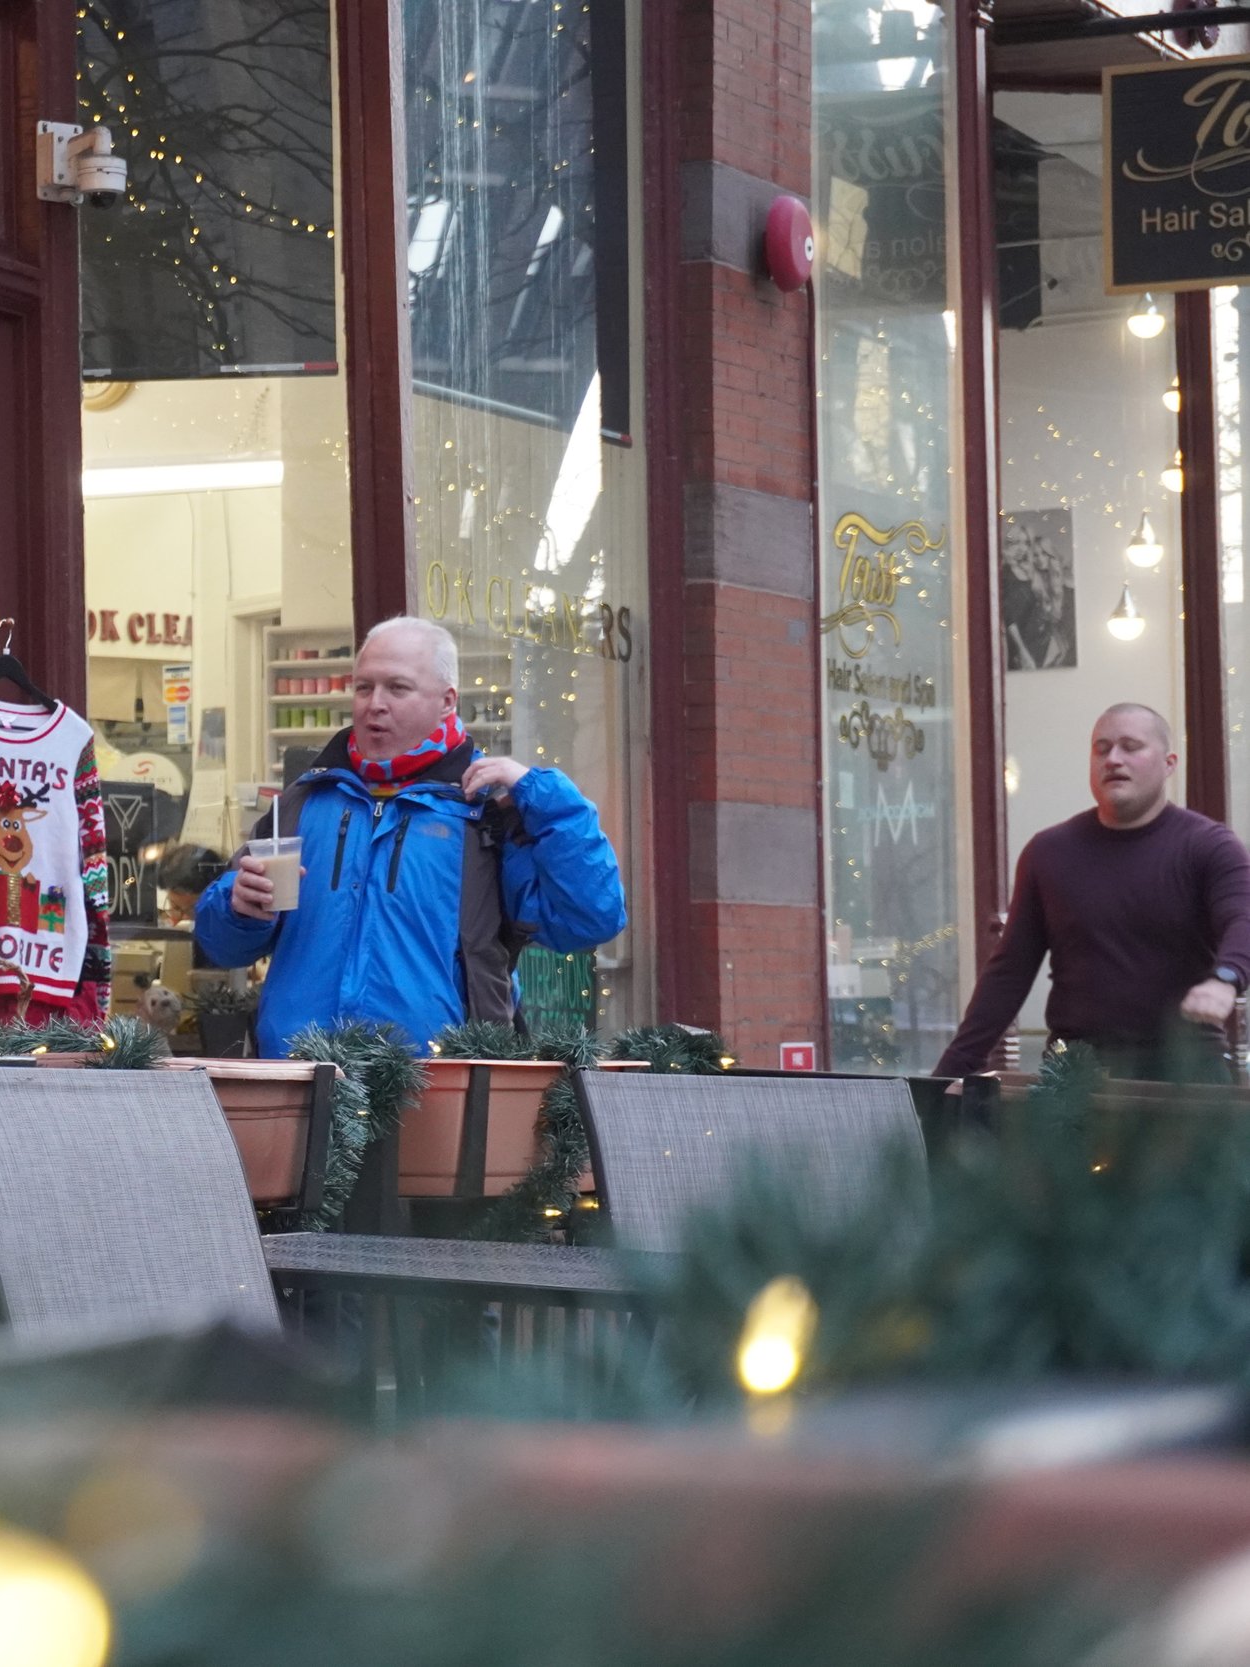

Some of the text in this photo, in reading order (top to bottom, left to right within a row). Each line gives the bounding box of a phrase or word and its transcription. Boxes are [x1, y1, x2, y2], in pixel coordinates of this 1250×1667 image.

[1141, 205, 1200, 233] Hair
[427, 560, 475, 625] OK
[107, 856, 146, 915] DRY
